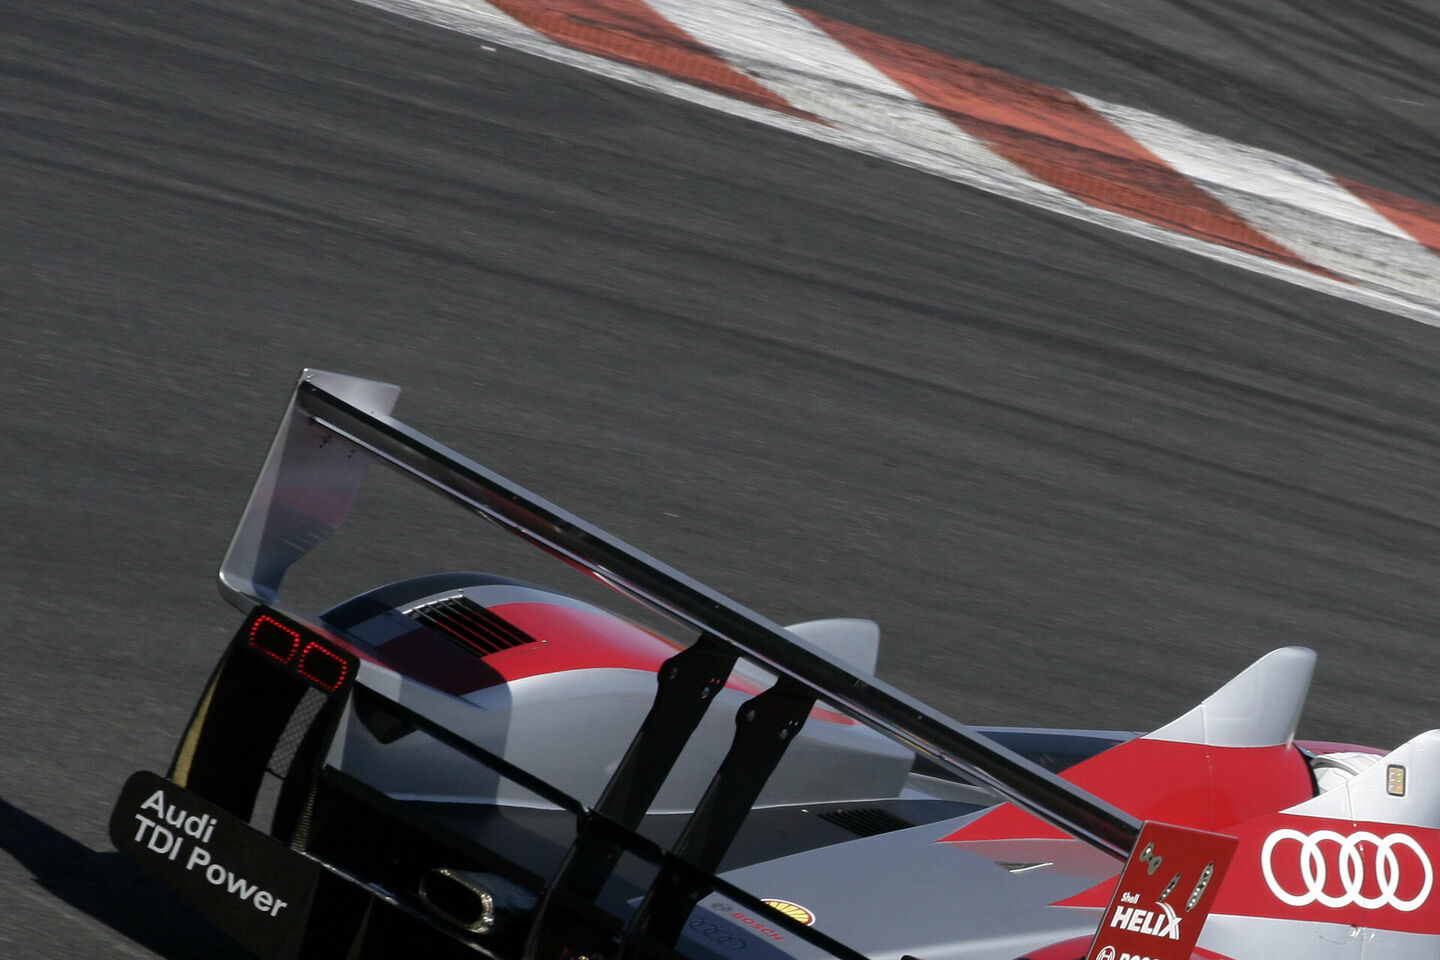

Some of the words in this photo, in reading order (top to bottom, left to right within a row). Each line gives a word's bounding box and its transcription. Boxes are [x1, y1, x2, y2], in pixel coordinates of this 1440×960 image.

[141, 790, 218, 843] Audi
[133, 814, 183, 861] TDI
[186, 846, 287, 917] Power
[731, 912, 785, 941] BOSCH
[1110, 901, 1182, 940] HELIX
